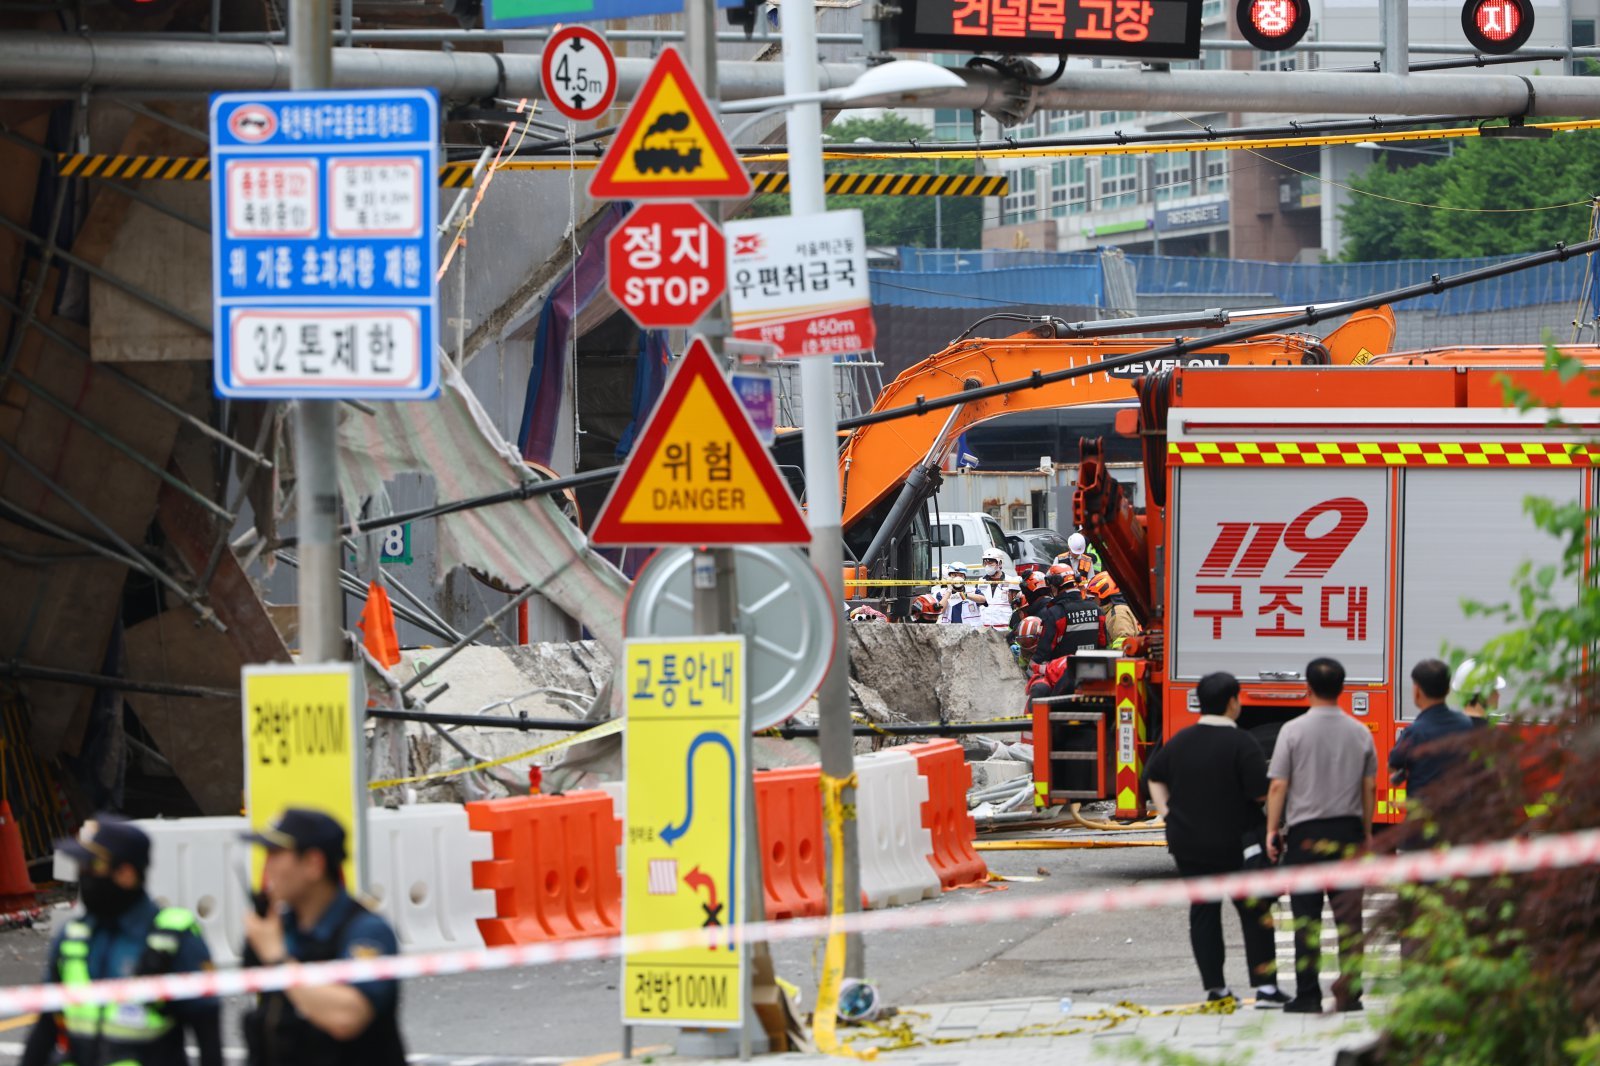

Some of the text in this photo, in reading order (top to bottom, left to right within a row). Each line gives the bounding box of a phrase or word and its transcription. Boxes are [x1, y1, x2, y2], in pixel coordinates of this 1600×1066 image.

[952, 0, 1154, 42] 건널목 고장
[1258, 0, 1287, 31] 정
[1483, 4, 1511, 33] 지
[555, 53, 602, 94] 4.5m
[623, 223, 709, 269] 정지
[624, 277, 709, 306] STOP
[734, 258, 857, 299] 우편취급국
[807, 317, 856, 336] 450m
[253, 324, 395, 374] 32톤제한
[662, 441, 732, 482] 위험
[653, 488, 746, 511] DANGER
[1196, 497, 1368, 578] 119
[1194, 585, 1368, 641] 구조대
[633, 652, 734, 708] 교통안내
[635, 972, 727, 1014] 전방100M
